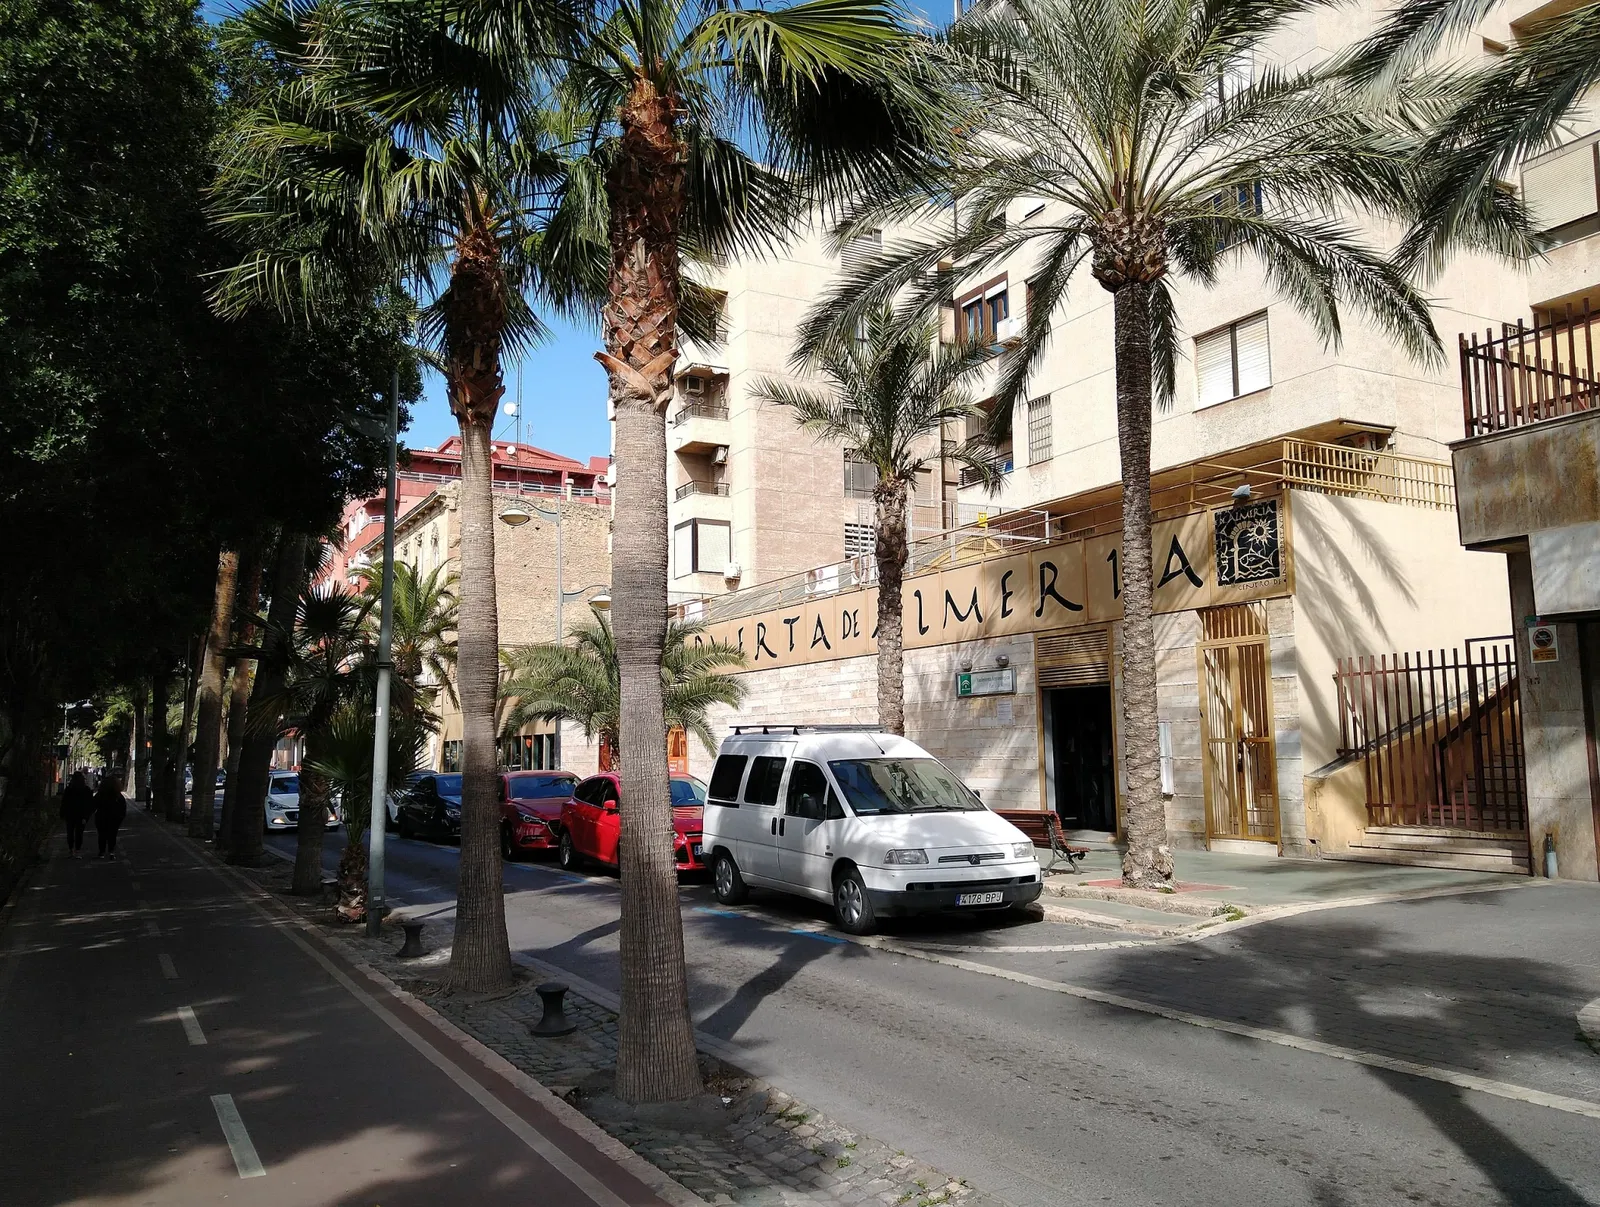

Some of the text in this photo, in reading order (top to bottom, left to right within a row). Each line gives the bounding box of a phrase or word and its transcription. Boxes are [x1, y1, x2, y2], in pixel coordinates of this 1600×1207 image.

[1220, 525, 1230, 582] PUERTA
[842, 608, 860, 640] DE
[872, 534, 1204, 639] LMERIA
[961, 893, 1001, 904] 4178 BPJ
